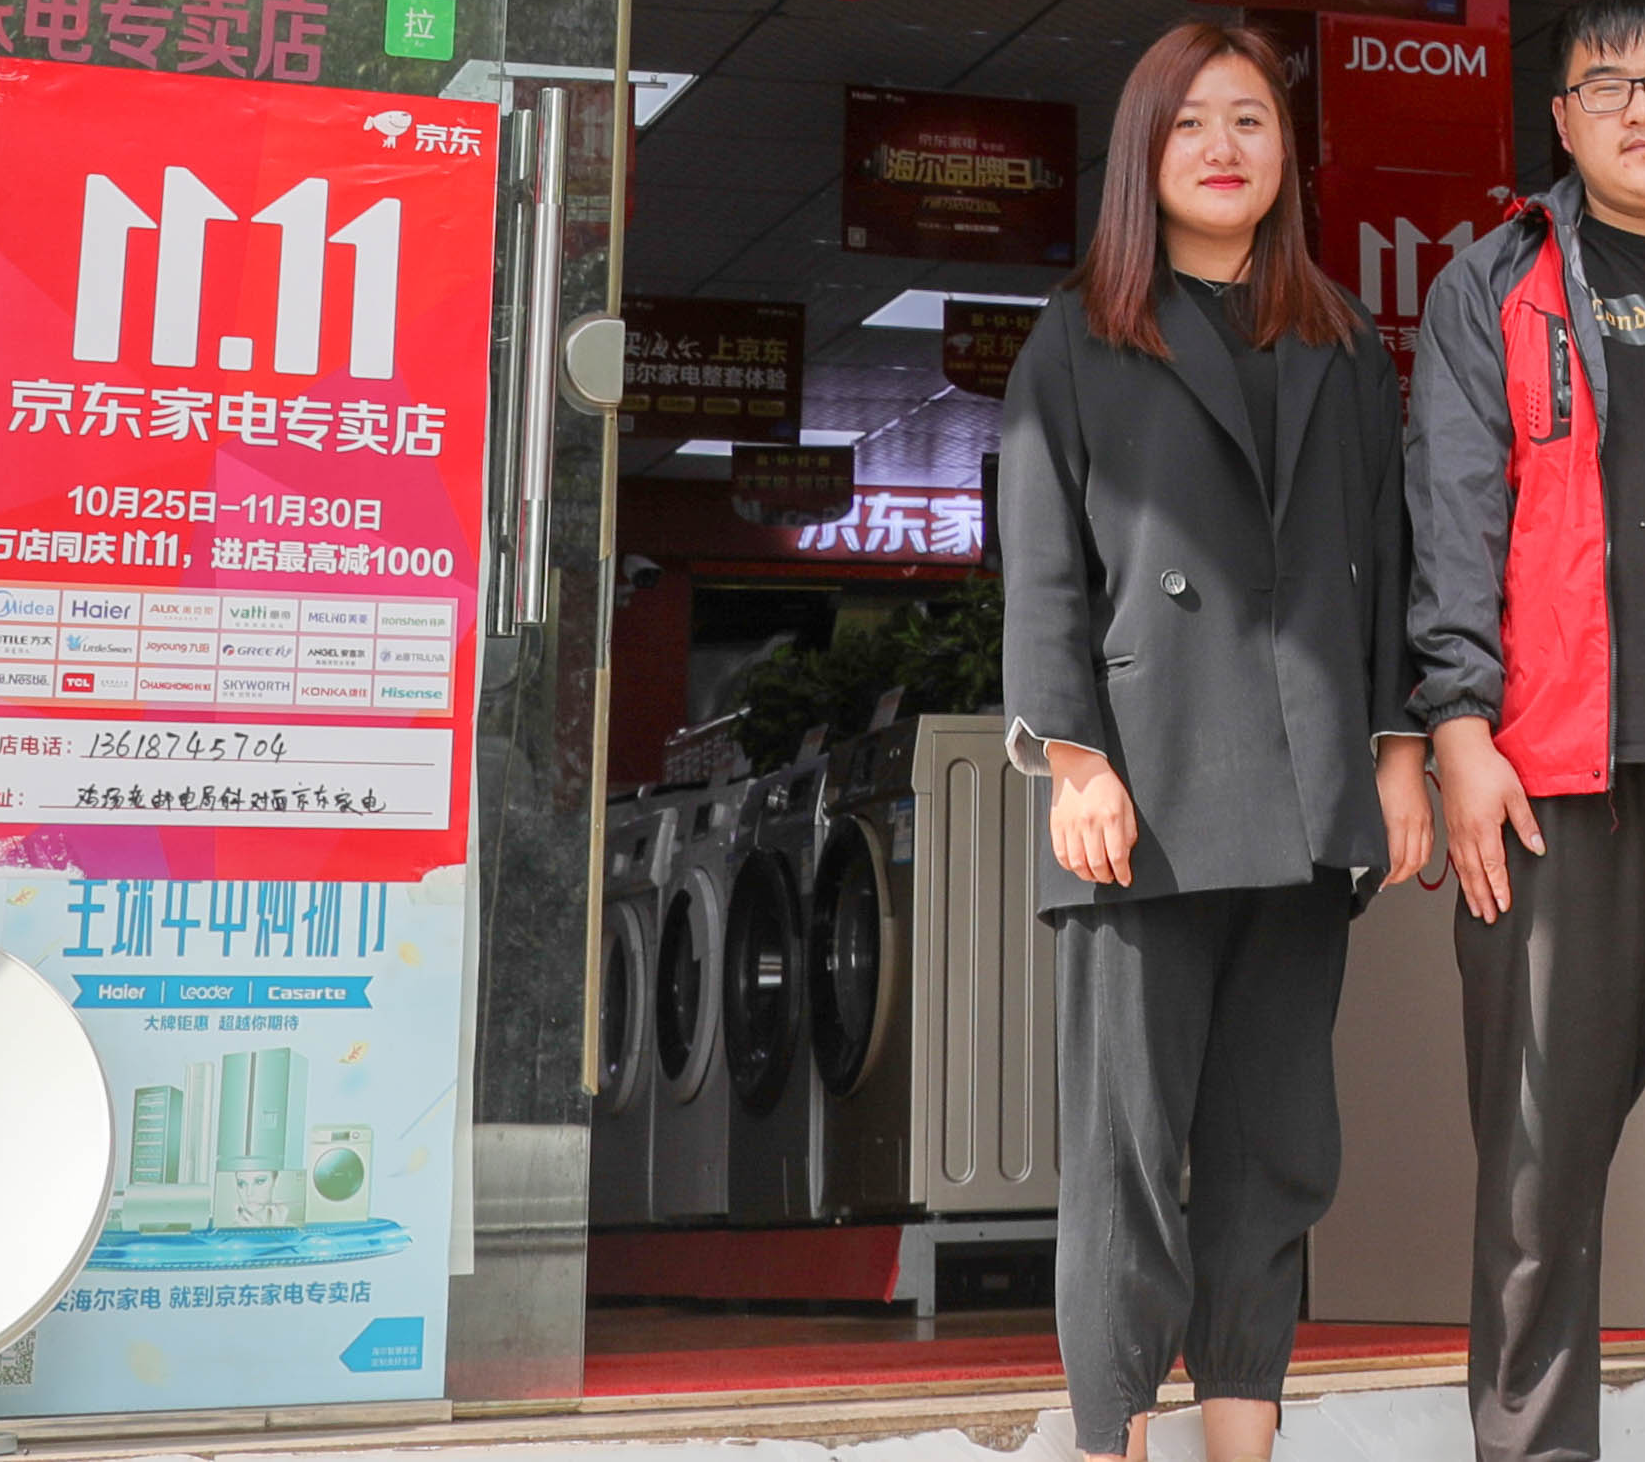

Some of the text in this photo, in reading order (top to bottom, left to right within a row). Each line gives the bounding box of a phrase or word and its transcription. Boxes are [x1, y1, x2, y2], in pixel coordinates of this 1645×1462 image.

[404, 7, 435, 40] 拉
[1344, 36, 1488, 78] JD.COM
[413, 122, 483, 157] 京东
[71, 165, 403, 380] 11.11
[7, 377, 447, 457] 京东家电专卖店
[71, 600, 131, 619] Haier
[150, 603, 179, 614] AUX
[66, 678, 90, 688] TCL
[222, 679, 290, 692] SKYWORTH
[301, 687, 347, 698] KONKA
[381, 687, 443, 699] Hisense
[88, 732, 289, 761] 13618745704
[98, 983, 348, 1001] Haier Leader Casarte
[144, 1014, 300, 1032] 大牌钜惠 超越你期待
[168, 1280, 372, 1309] 就到京东家电专卖店
